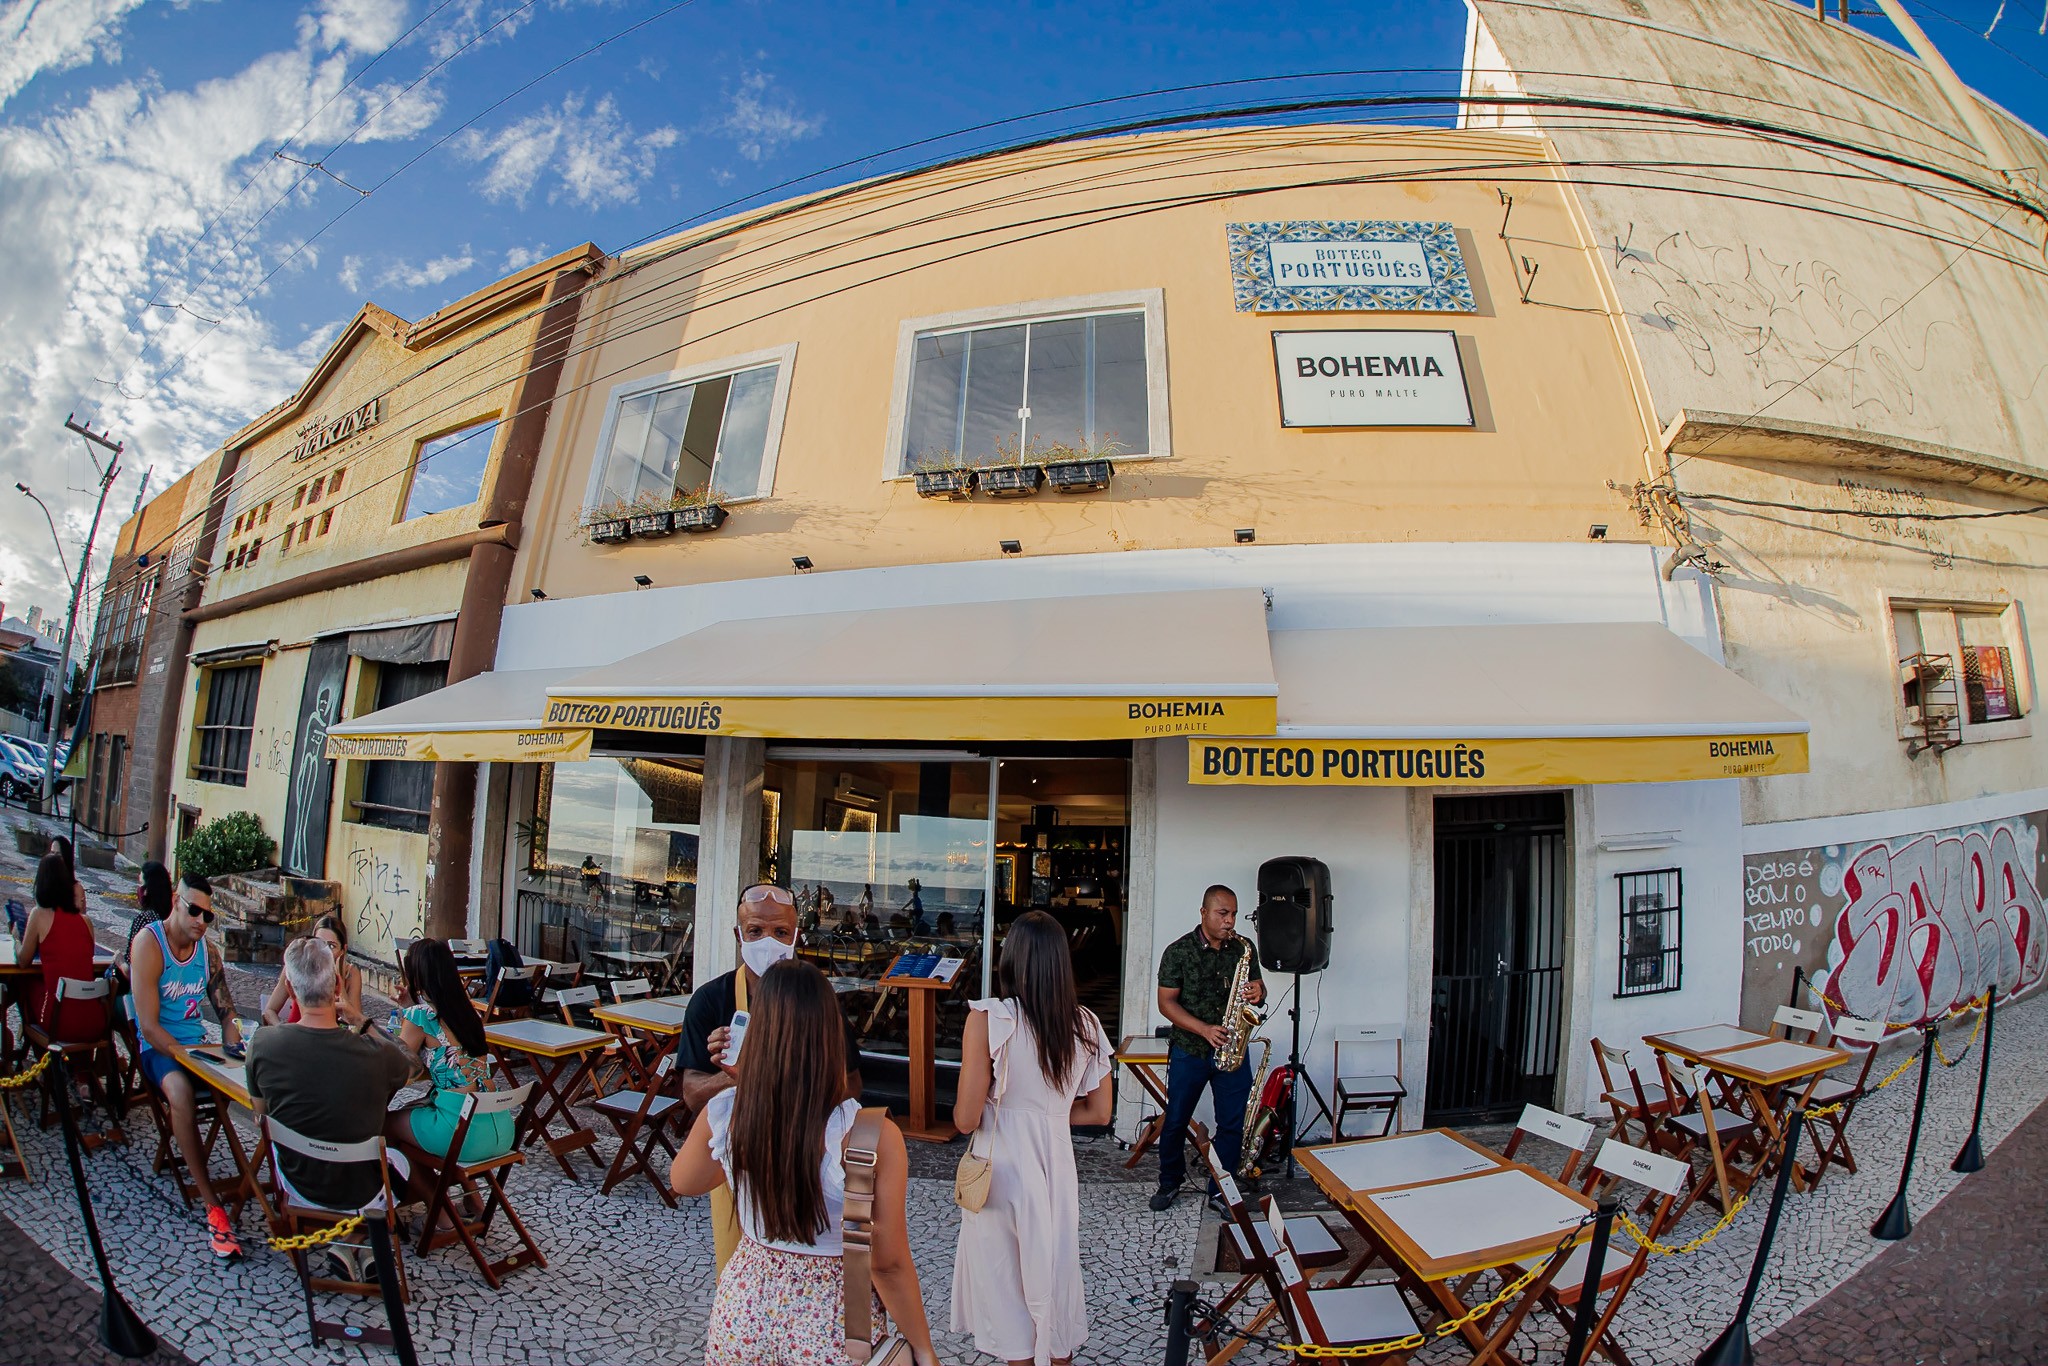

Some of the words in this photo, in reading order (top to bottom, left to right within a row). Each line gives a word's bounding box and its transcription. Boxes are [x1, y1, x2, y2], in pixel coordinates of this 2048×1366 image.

[1315, 248, 1382, 261] BOTECO
[1280, 260, 1422, 280] PORTUGUÊS
[1296, 356, 1444, 378] BOHEMIA
[1330, 389, 1365, 398] PURO
[1375, 389, 1419, 398] MALTE
[548, 703, 611, 724] BOTECO
[610, 701, 722, 730] PORTUGUÊS
[1128, 702, 1224, 719] BOHEMIA
[1145, 723, 1171, 733] PURO
[1176, 722, 1208, 731] MALTE
[328, 737, 357, 755] BOTECO
[357, 735, 408, 757] PORTUGUÊS
[518, 732, 564, 746] BOHEMIA
[1709, 740, 1774, 757] BOHEMIA
[1203, 746, 1314, 777] BOTECO
[1322, 743, 1485, 779] PORTUGUÊS
[1723, 765, 1741, 774] PURO
[1744, 763, 1765, 773] MALTE
[1745, 883, 1788, 906] BOM
[1795, 884, 1807, 903] O
[1744, 907, 1804, 933] TEMPO
[162, 976, 206, 1002] Miami
[309, 1141, 339, 1152] BOHEMIA
[1633, 1159, 1652, 1171] BOHEMIA
